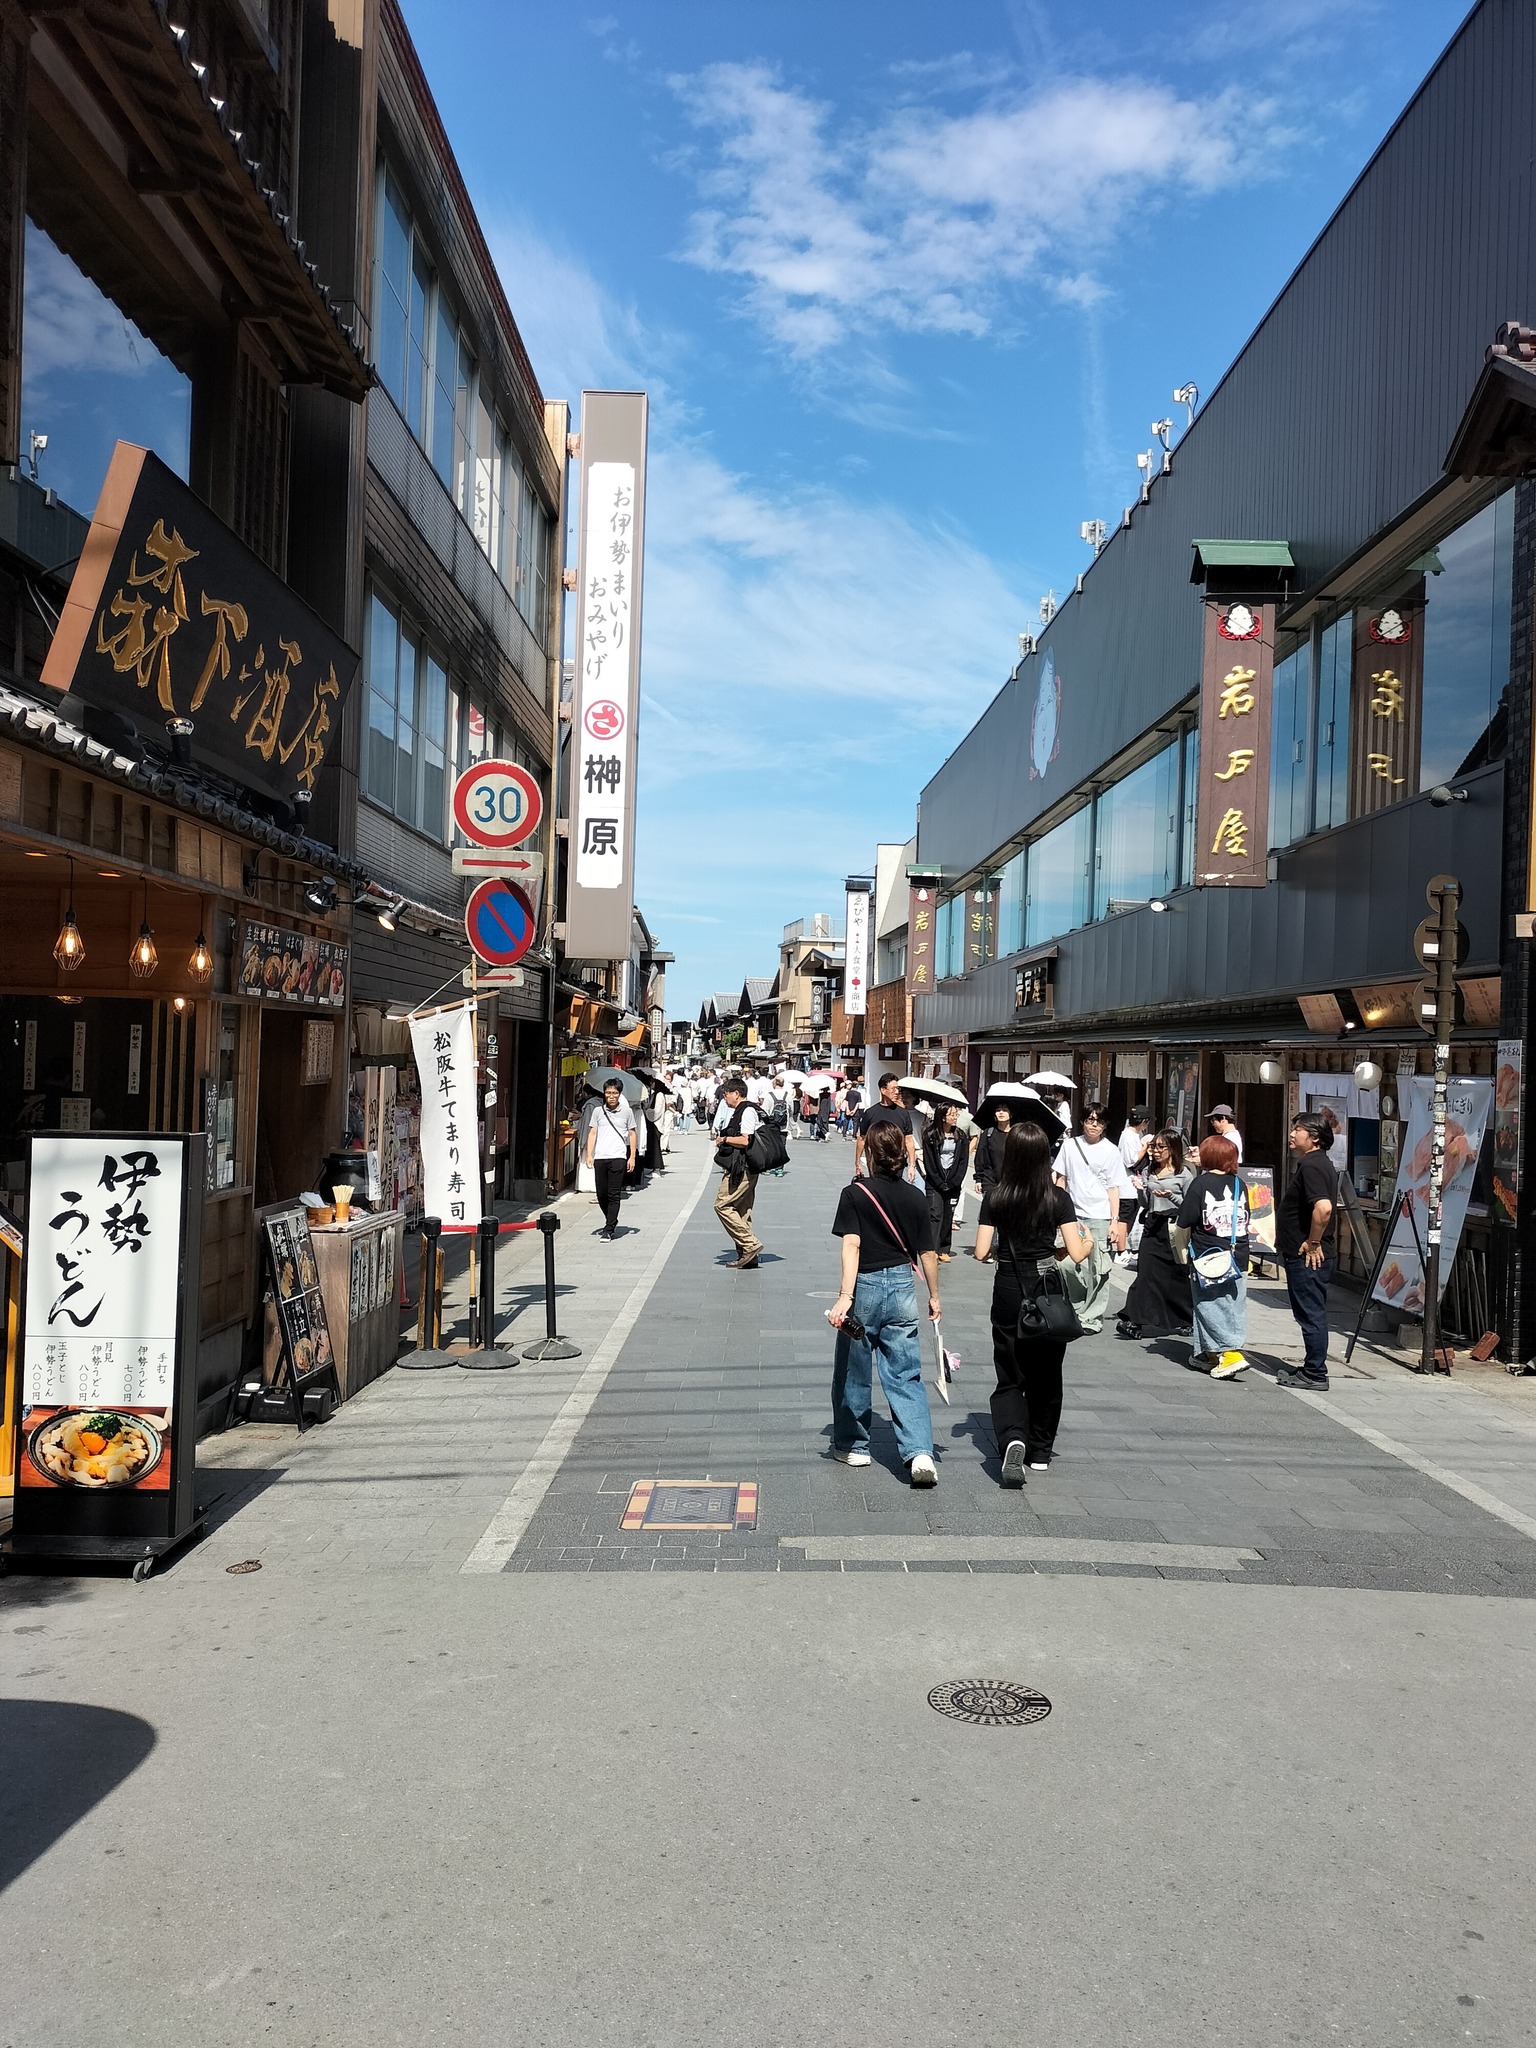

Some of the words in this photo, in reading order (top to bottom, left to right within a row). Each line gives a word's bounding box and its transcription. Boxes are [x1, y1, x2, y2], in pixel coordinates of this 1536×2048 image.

[609, 486, 632, 649] お伊勢まいり
[586, 576, 608, 681] おみやげ
[1211, 665, 1257, 858] 岩戸屋
[474, 785, 522, 824] 30
[582, 753, 621, 856] 榊原
[913, 910, 930, 984] 岩戸屋
[432, 1031, 467, 1221] 松阪牛てまり寿司
[97, 1150, 162, 1256] 伊勢
[48, 1190, 107, 1328] うどん
[44, 1343, 56, 1398] 伊勢うどん
[57, 1341, 68, 1384] 玉子とじ
[90, 1344, 102, 1399] 伊勢うどん
[104, 1341, 114, 1364] 月見
[137, 1345, 149, 1399] 伊勢うどん
[157, 1352, 169, 1385] 手打ち
